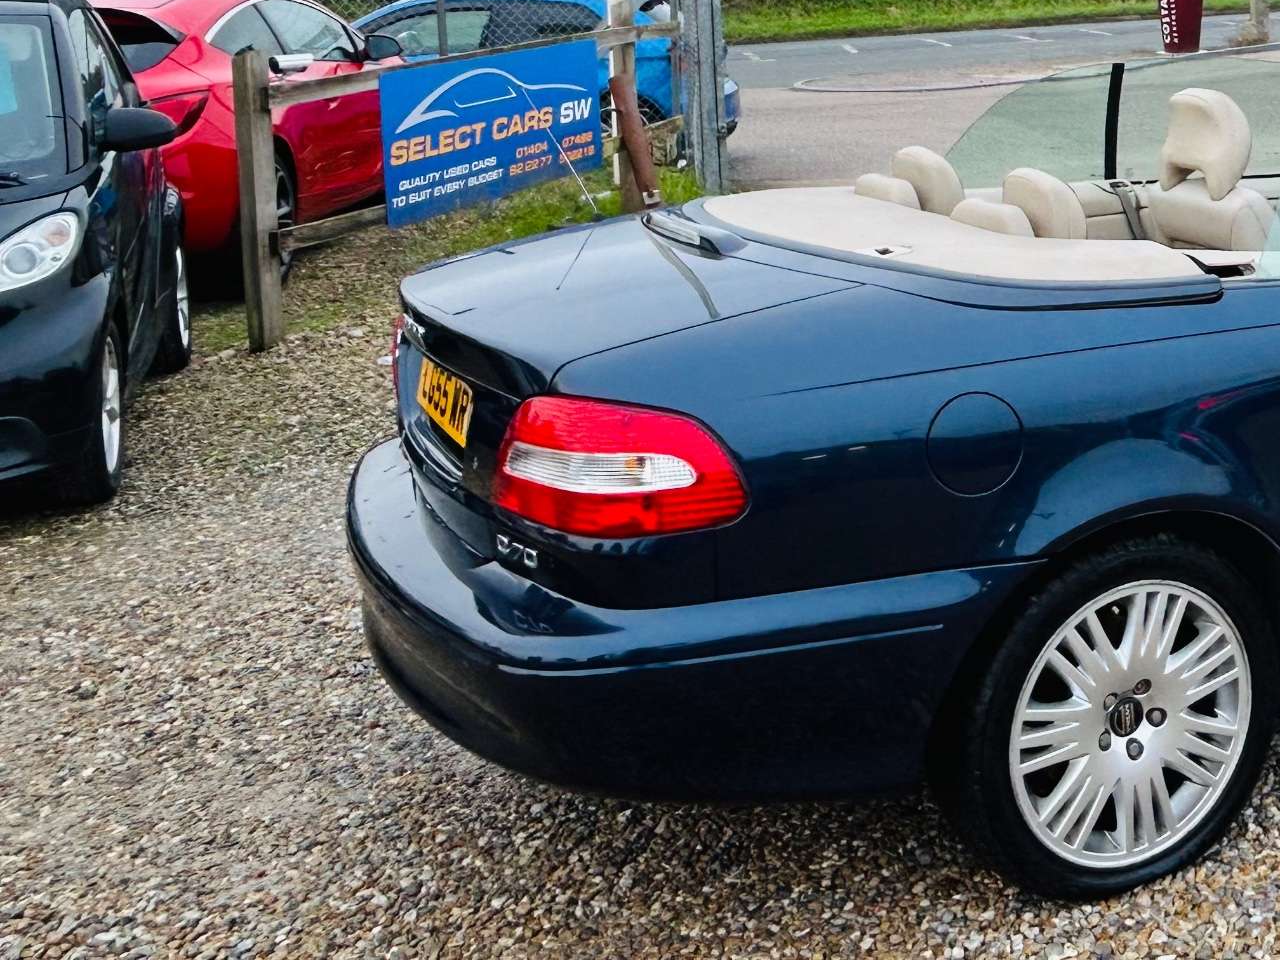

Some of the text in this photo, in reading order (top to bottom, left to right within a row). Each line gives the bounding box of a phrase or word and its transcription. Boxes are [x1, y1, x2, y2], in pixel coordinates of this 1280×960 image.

[390, 97, 592, 166] SELECT CARS SW
[391, 169, 504, 208] TO SUIT EVERY BUDGET
[398, 156, 497, 191] QUALITY USED CARS
